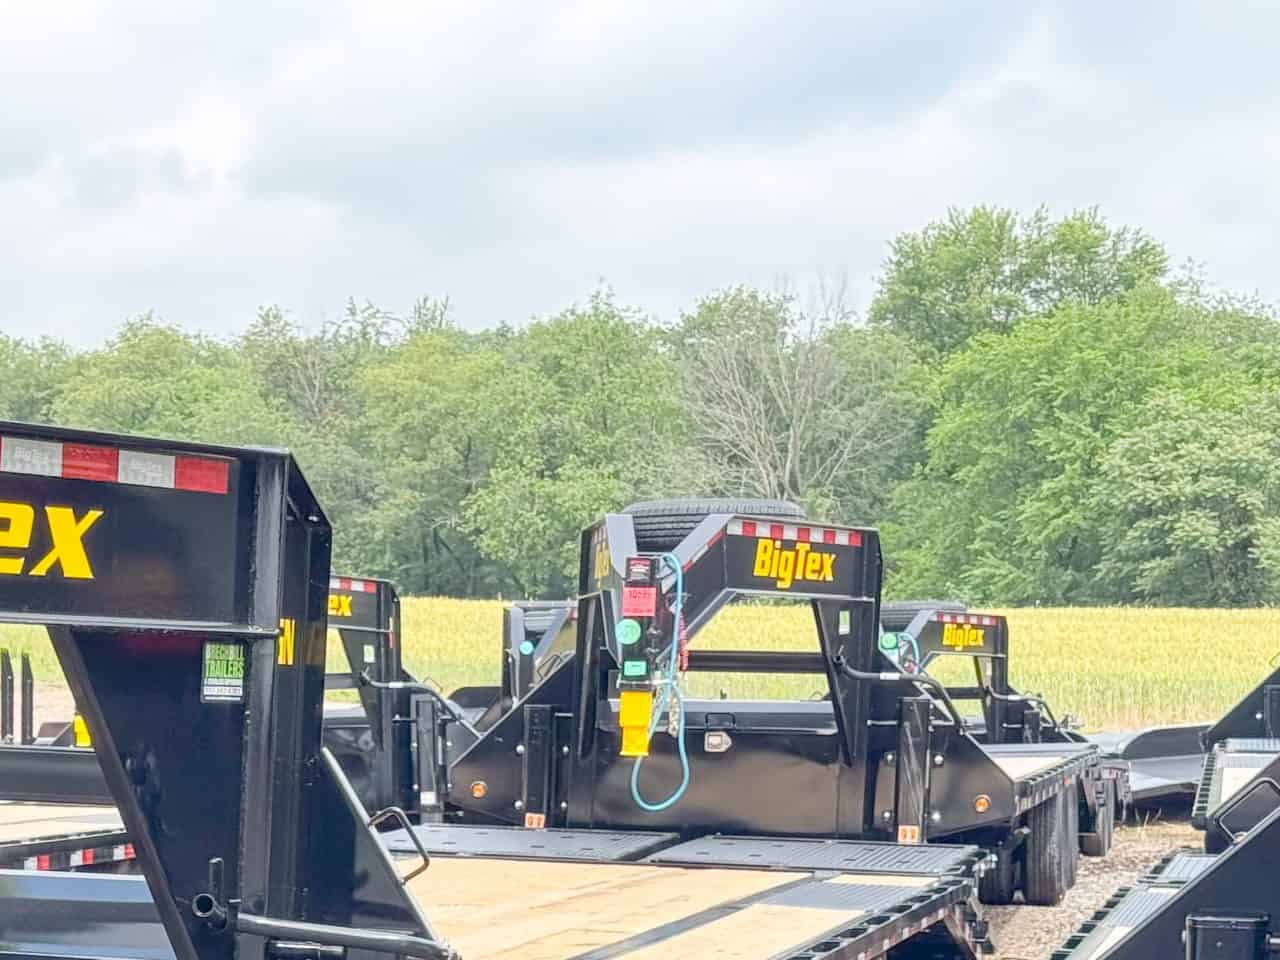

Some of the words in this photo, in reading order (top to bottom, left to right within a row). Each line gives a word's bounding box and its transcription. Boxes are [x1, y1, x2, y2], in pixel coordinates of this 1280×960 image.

[753, 538, 837, 589] BigTex
[942, 623, 985, 651] BigTex
[206, 659, 244, 678] TRAILERS
